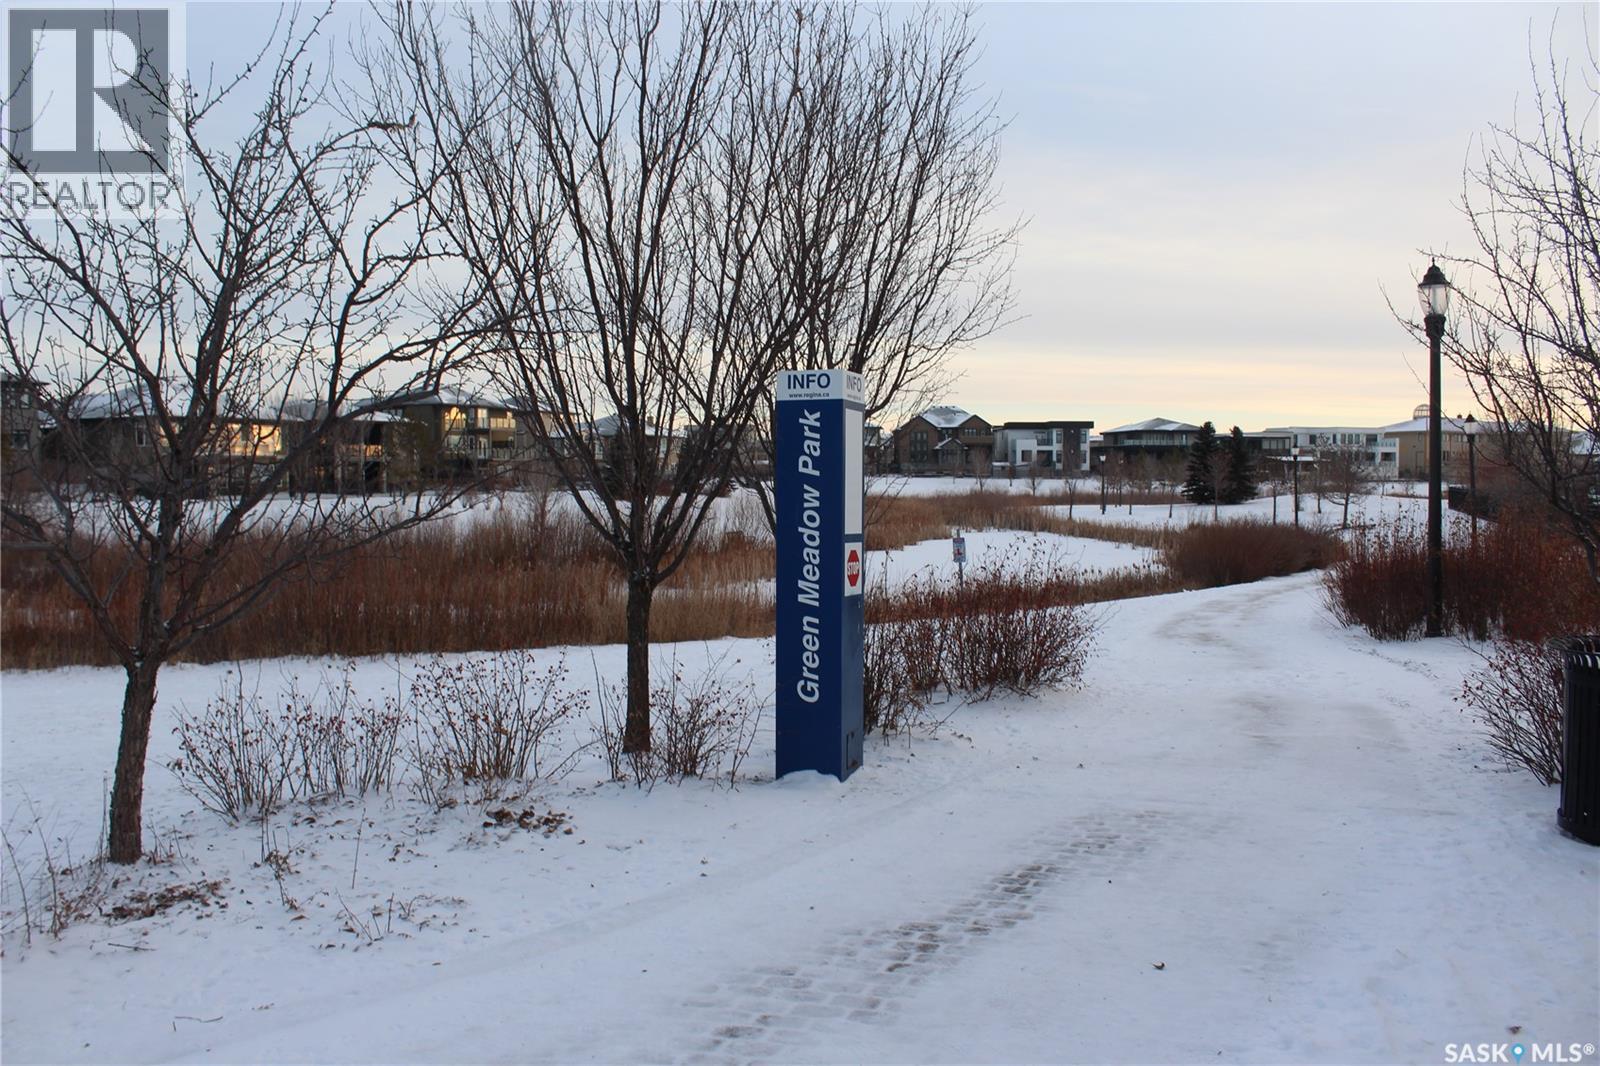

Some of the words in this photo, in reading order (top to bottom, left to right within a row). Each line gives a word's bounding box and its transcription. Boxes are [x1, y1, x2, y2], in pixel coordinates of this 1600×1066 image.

[787, 373, 831, 389] INFO
[846, 374, 862, 393] INFO
[788, 391, 830, 399] www.regina.ca
[799, 409, 821, 476] Park
[798, 484, 820, 607] Meadow
[847, 561, 860, 575] STOP
[797, 615, 820, 704] Green
